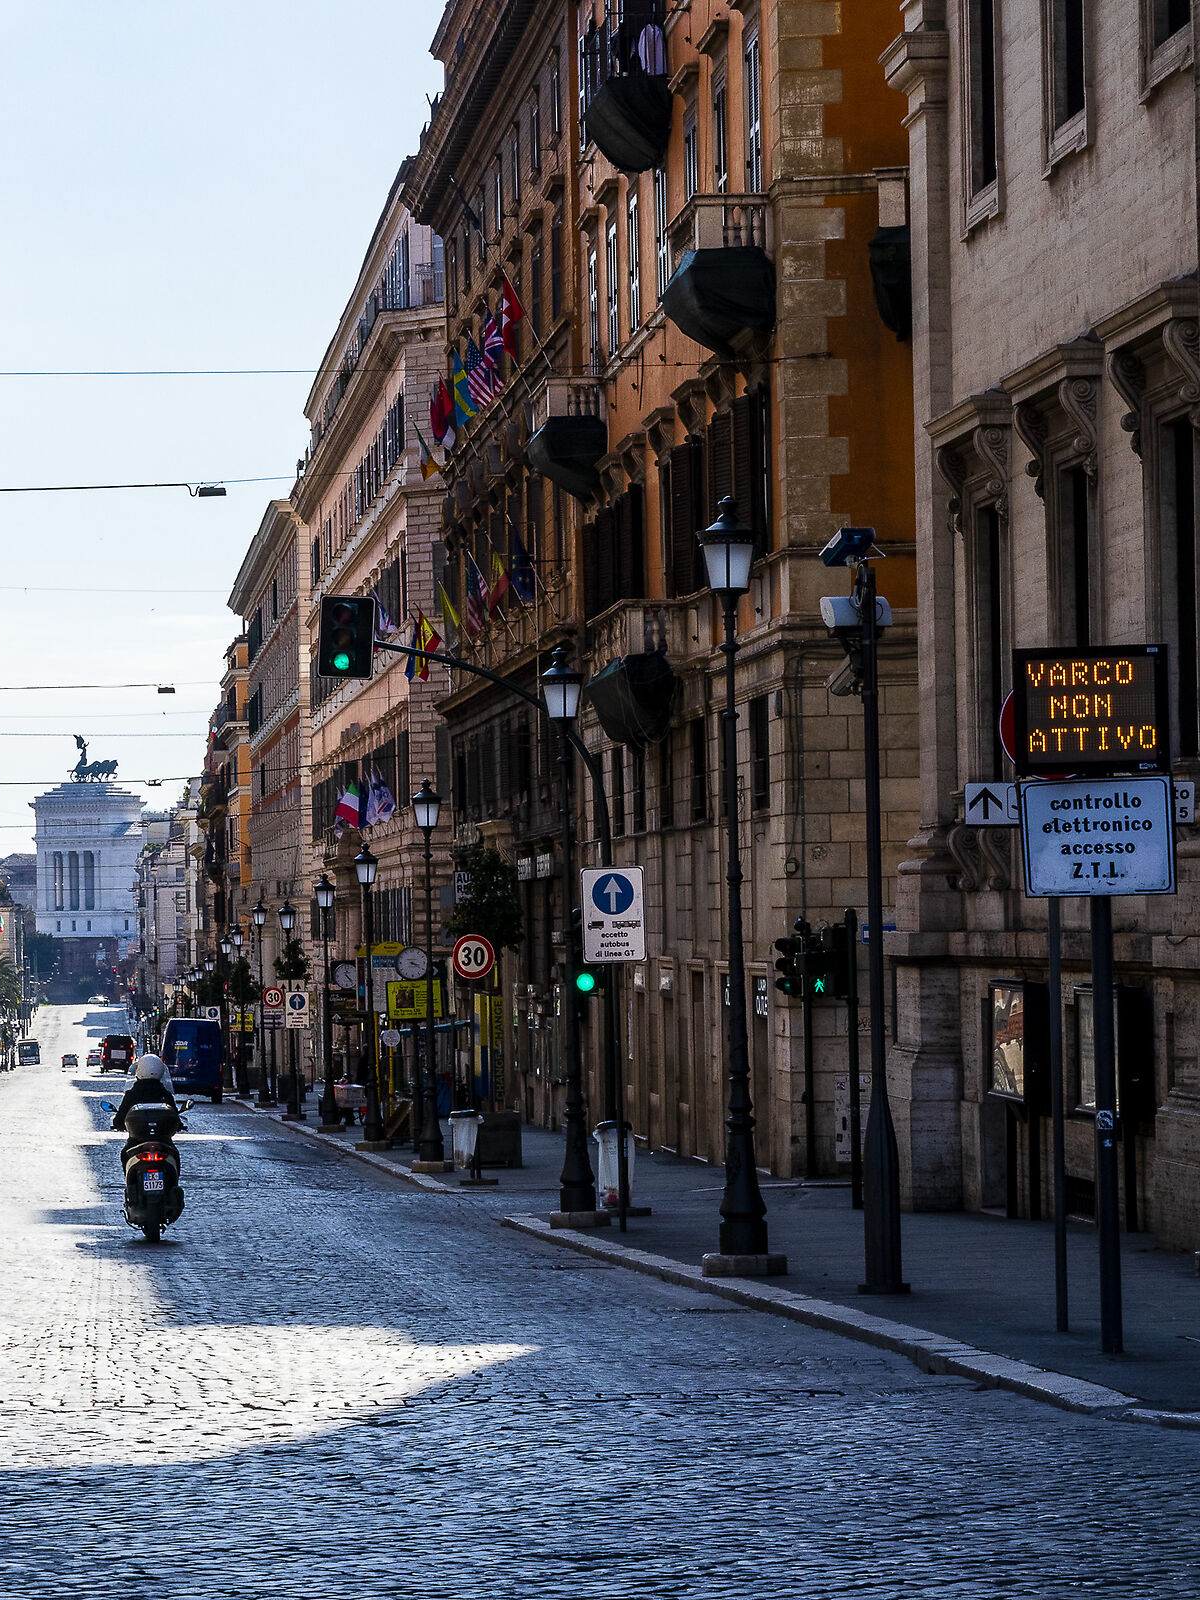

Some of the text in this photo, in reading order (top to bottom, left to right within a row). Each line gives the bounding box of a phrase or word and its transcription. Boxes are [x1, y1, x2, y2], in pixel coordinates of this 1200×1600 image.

[1027, 660, 1133, 687] VARCO
[1050, 694, 1112, 719] NON
[1029, 725, 1156, 752] ATTIVO
[1050, 792, 1142, 811] controllo
[1042, 815, 1153, 834] elettronico
[1060, 841, 1136, 855] accesso
[1073, 861, 1125, 879] Z.T.L.
[595, 950, 603, 958] di
[624, 949, 635, 957] GT
[600, 940, 629, 948] autobus
[461, 946, 486, 967] 30
[267, 992, 280, 1003] 30
[494, 999, 504, 1048] CHANGE
